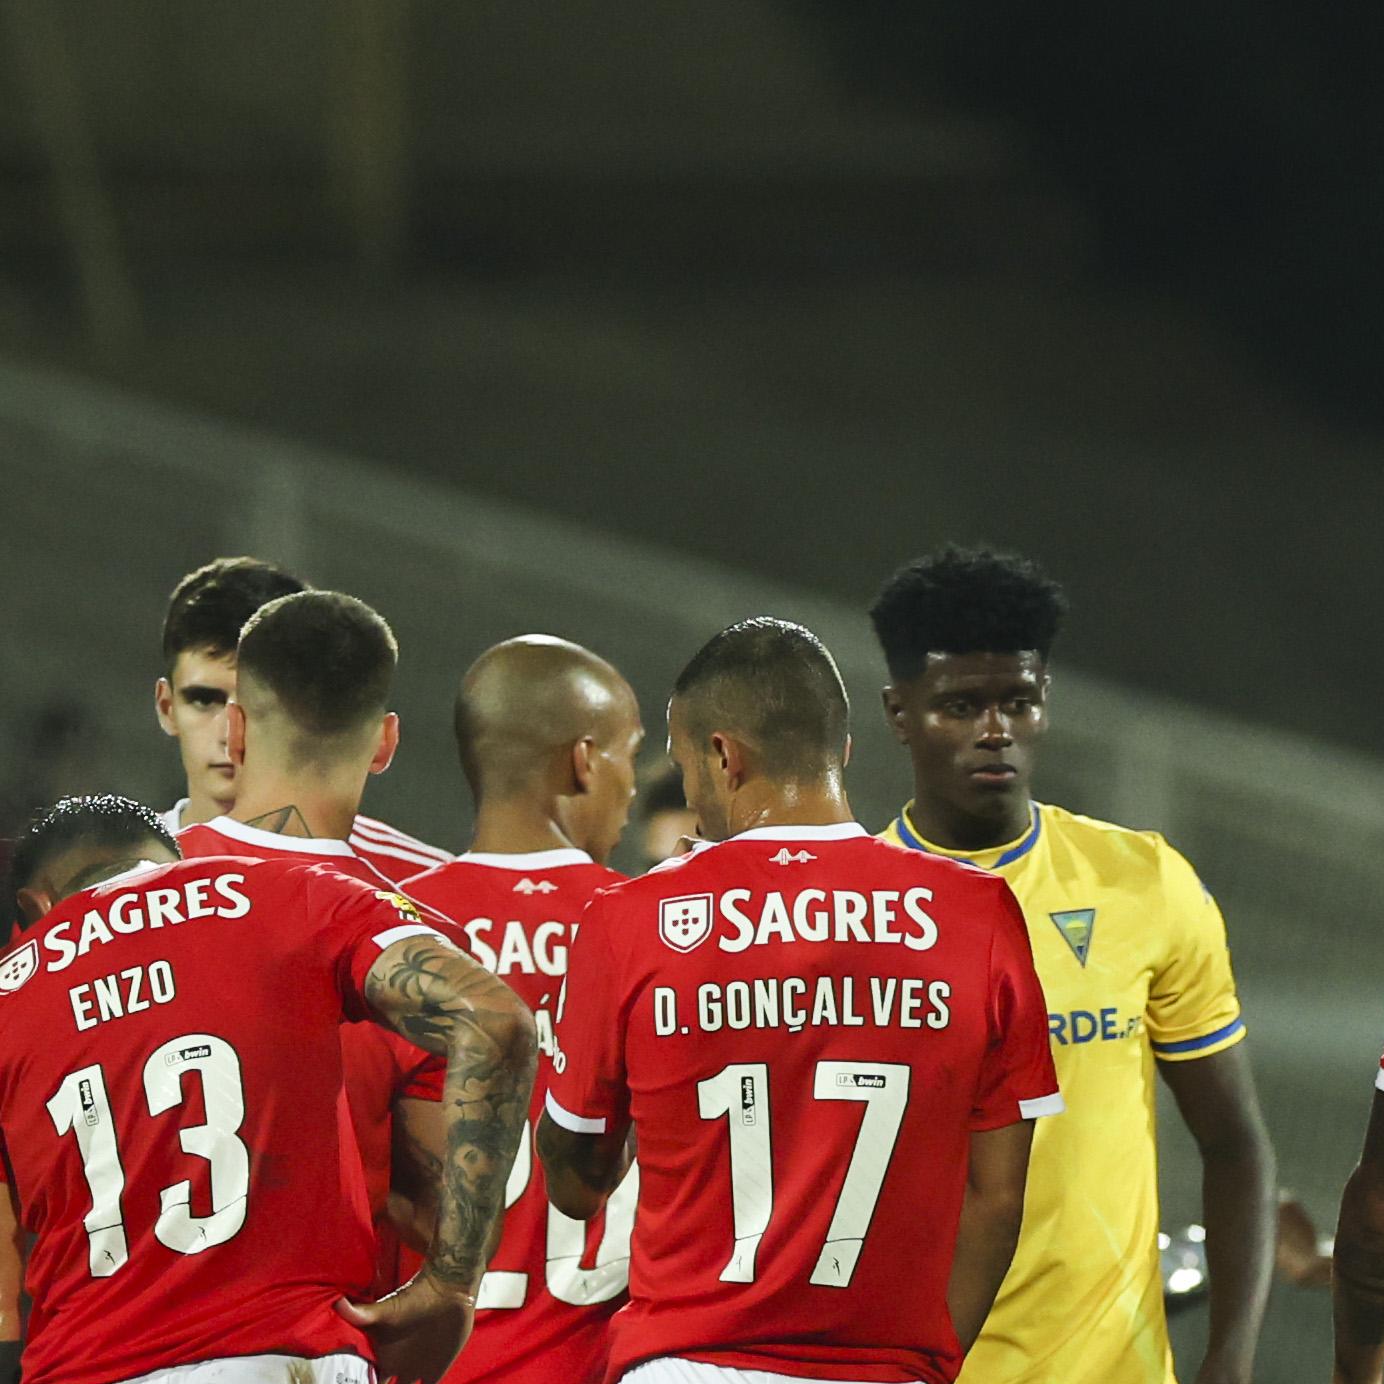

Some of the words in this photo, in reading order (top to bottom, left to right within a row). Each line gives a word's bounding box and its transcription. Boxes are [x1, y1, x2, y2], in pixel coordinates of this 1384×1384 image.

[43, 873, 252, 972] SAGRES
[464, 918, 579, 977] SAG
[718, 887, 938, 952] SAGRES
[69, 959, 176, 1033] ENZO
[654, 987, 689, 1036] D.
[698, 976, 951, 1034] GONÇALVES
[184, 1046, 209, 1060] bwin
[858, 1076, 884, 1087] bwin
[80, 1081, 93, 1104] bwin
[743, 1078, 754, 1104] bwin
[46, 1033, 250, 1277] 13
[698, 1060, 911, 1288] 17
